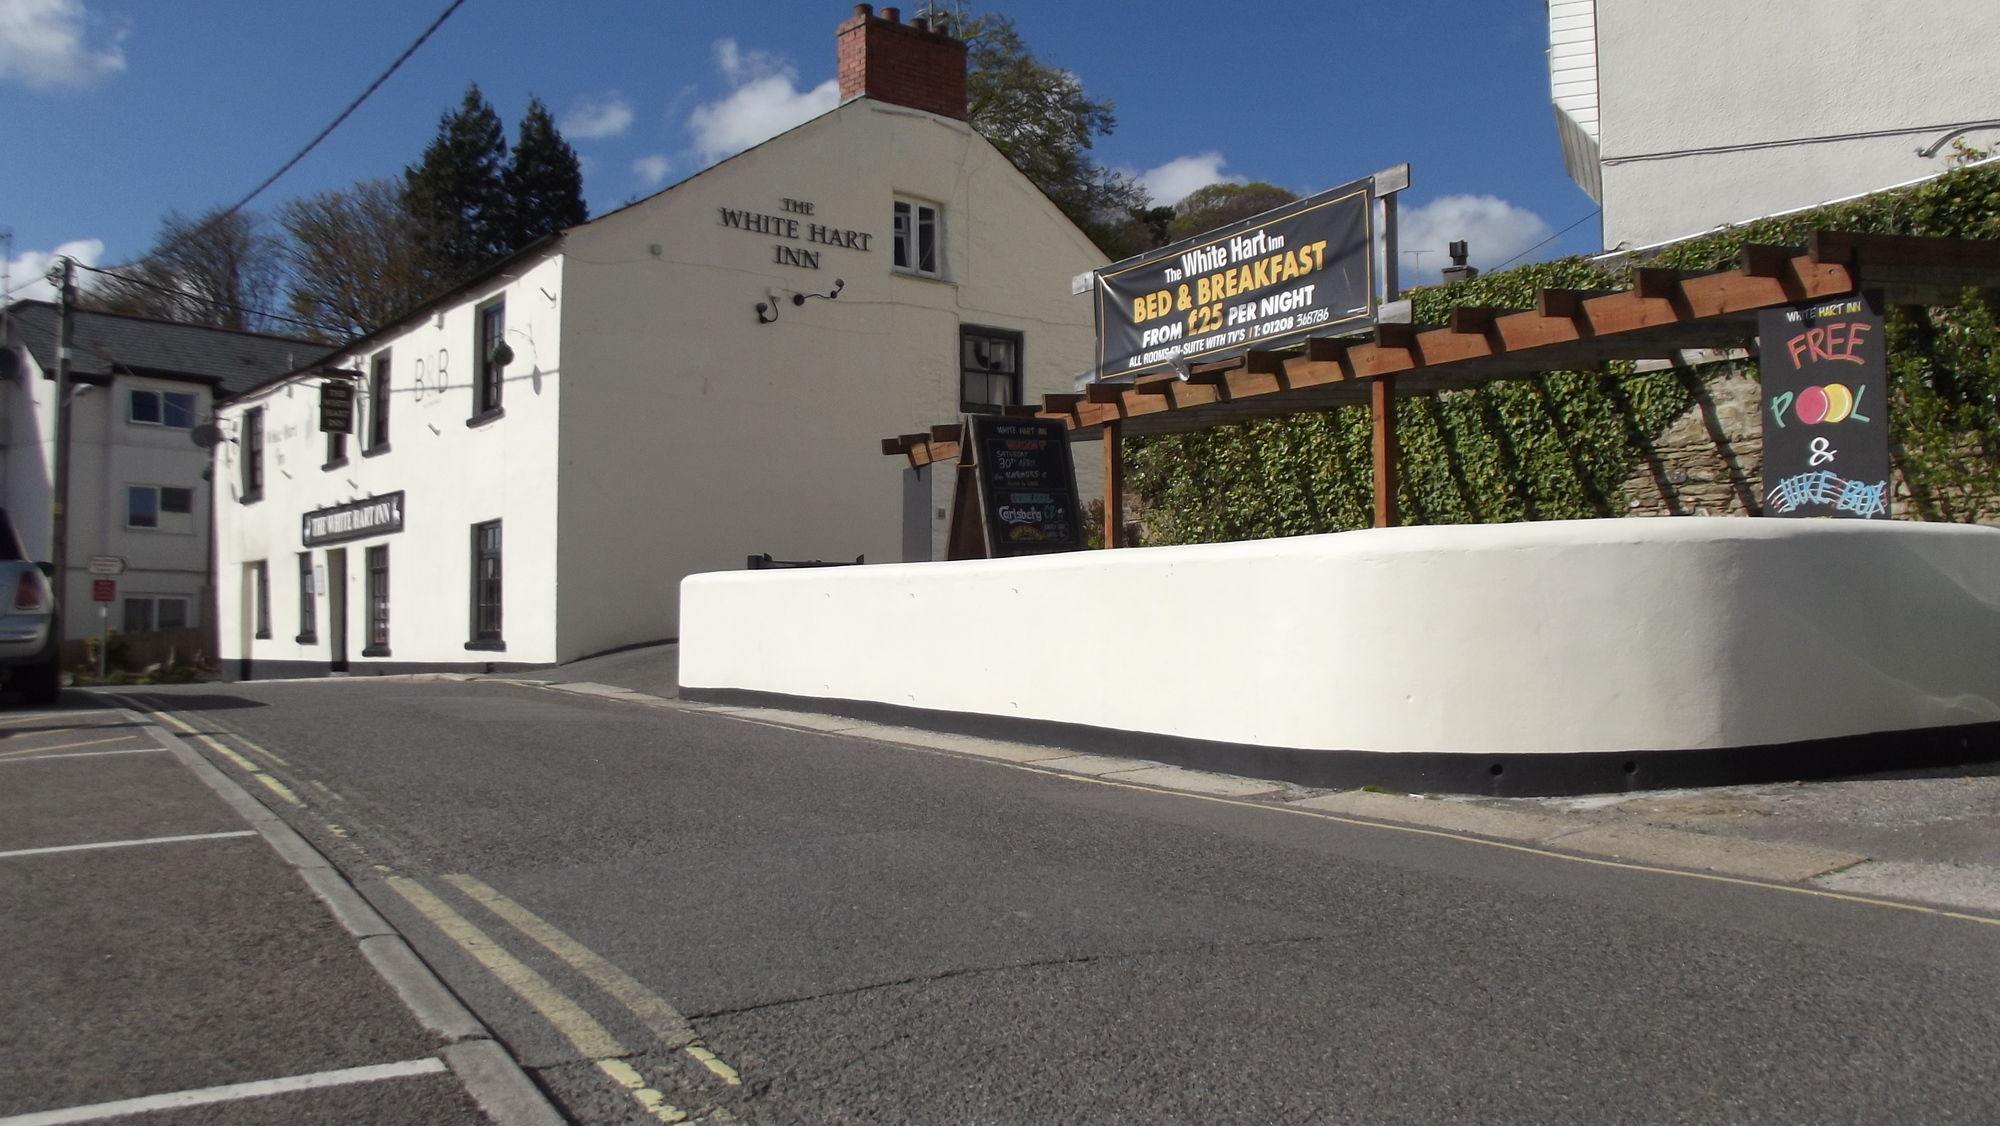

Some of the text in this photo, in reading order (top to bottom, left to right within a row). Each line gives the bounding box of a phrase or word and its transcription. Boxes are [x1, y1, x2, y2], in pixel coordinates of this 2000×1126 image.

[719, 207, 872, 251] WHITE HART
[782, 198, 814, 216] THE
[774, 244, 820, 270] INN
[1164, 229, 1285, 283] The White Hart Inn
[1133, 240, 1327, 324] BED & BREAKFAST
[1142, 284, 1316, 349] FROM £25 PER NIGHT
[1818, 303, 1845, 318] HART
[1846, 301, 1862, 313] INN
[1129, 355, 1142, 368] ALL
[1206, 333, 1226, 352] WITH
[1228, 329, 1246, 347] TV'S
[1262, 316, 1294, 336] 01208
[1296, 307, 1330, 328] 368786
[1787, 323, 1872, 370] FREE
[1770, 383, 1871, 429] POOL
[1809, 436, 1838, 467] &
[999, 505, 1042, 522] Carlsberg
[1781, 470, 1888, 519] JUKE BOX
[311, 503, 390, 537] THE WHITE HART INN
